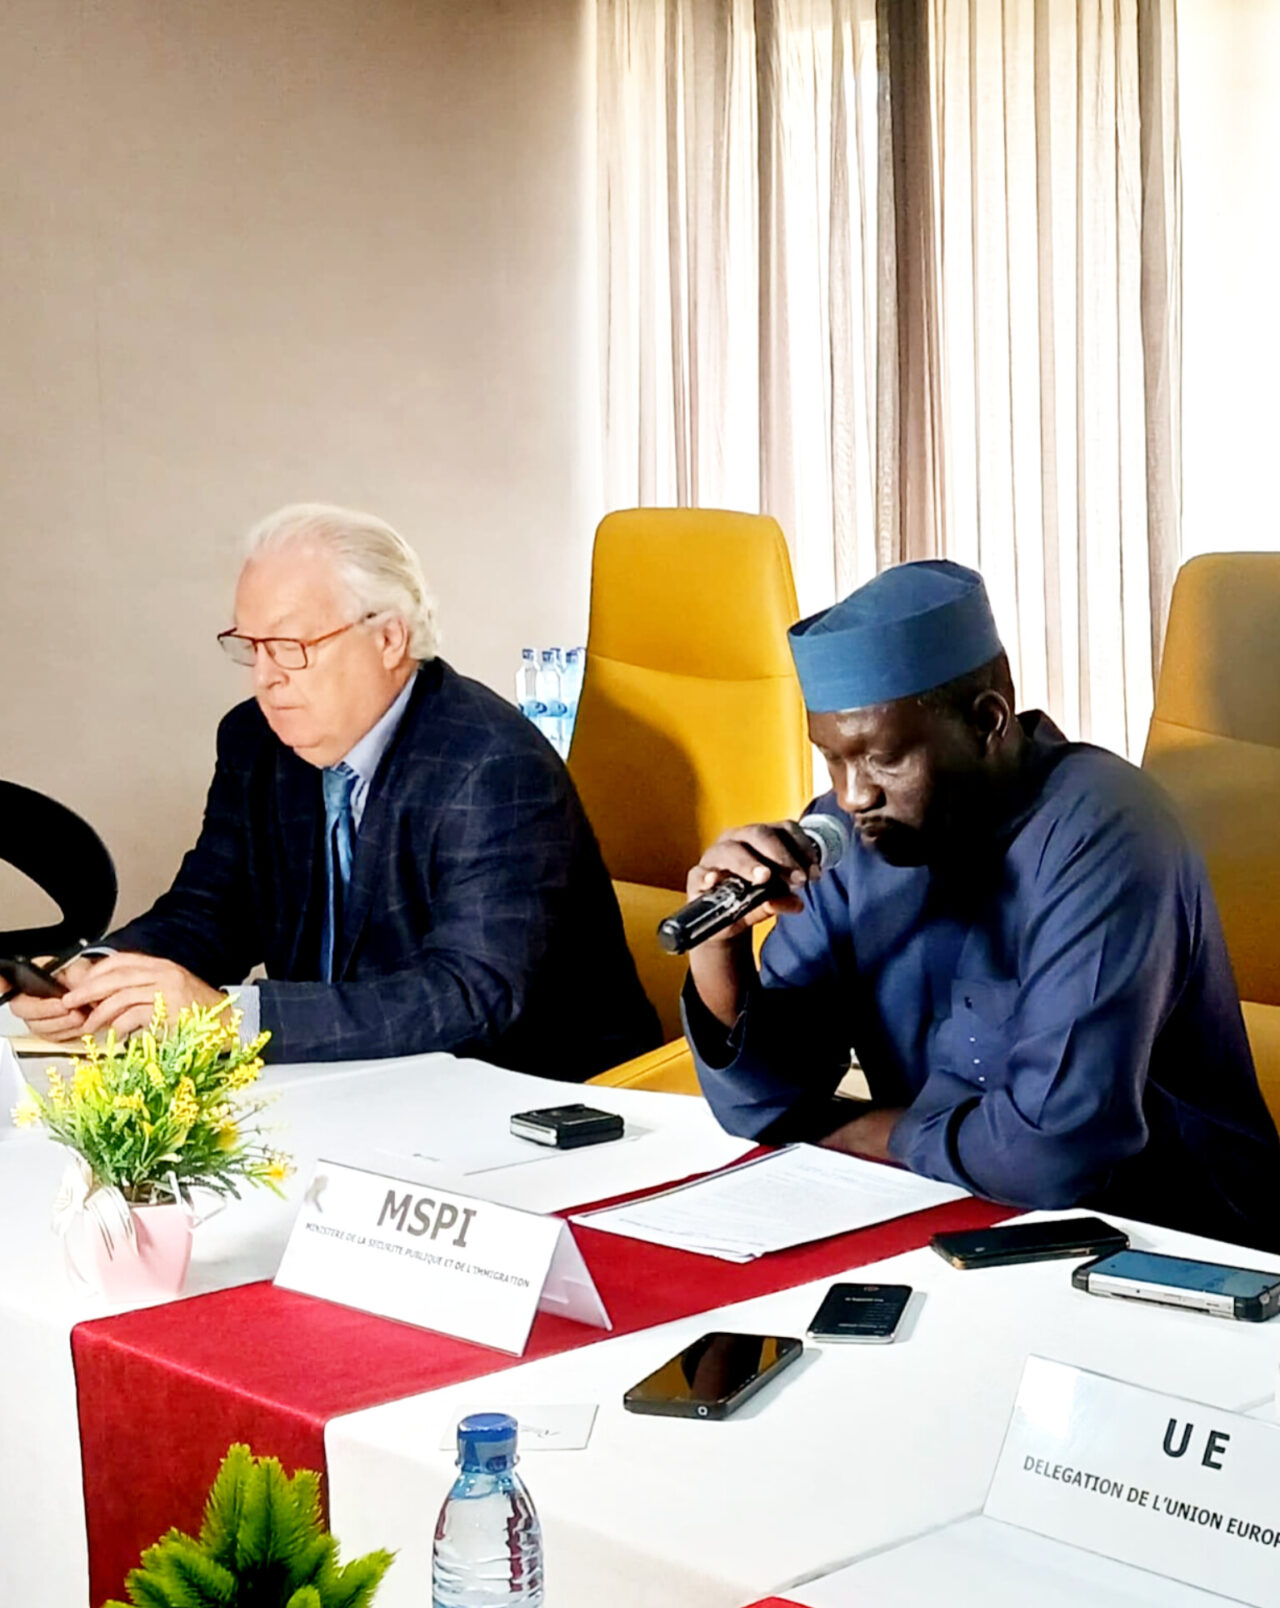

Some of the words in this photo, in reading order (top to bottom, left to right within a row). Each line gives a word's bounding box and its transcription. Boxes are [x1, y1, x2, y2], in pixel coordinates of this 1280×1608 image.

[376, 1189, 478, 1248] MSPI
[305, 1222, 345, 1240] MINISTERE
[345, 1231, 357, 1243] DE
[358, 1234, 367, 1245] LA
[368, 1238, 404, 1255] SECURITE
[404, 1247, 443, 1265] PUBLIQUE
[444, 1256, 454, 1268] ET
[455, 1260, 466, 1272] DE
[466, 1263, 531, 1288] L'IMMIGRATION
[1023, 1455, 1124, 1499] DELEGATION
[1126, 1486, 1150, 1508] DE
[1152, 1495, 1224, 1531] L'UNION
